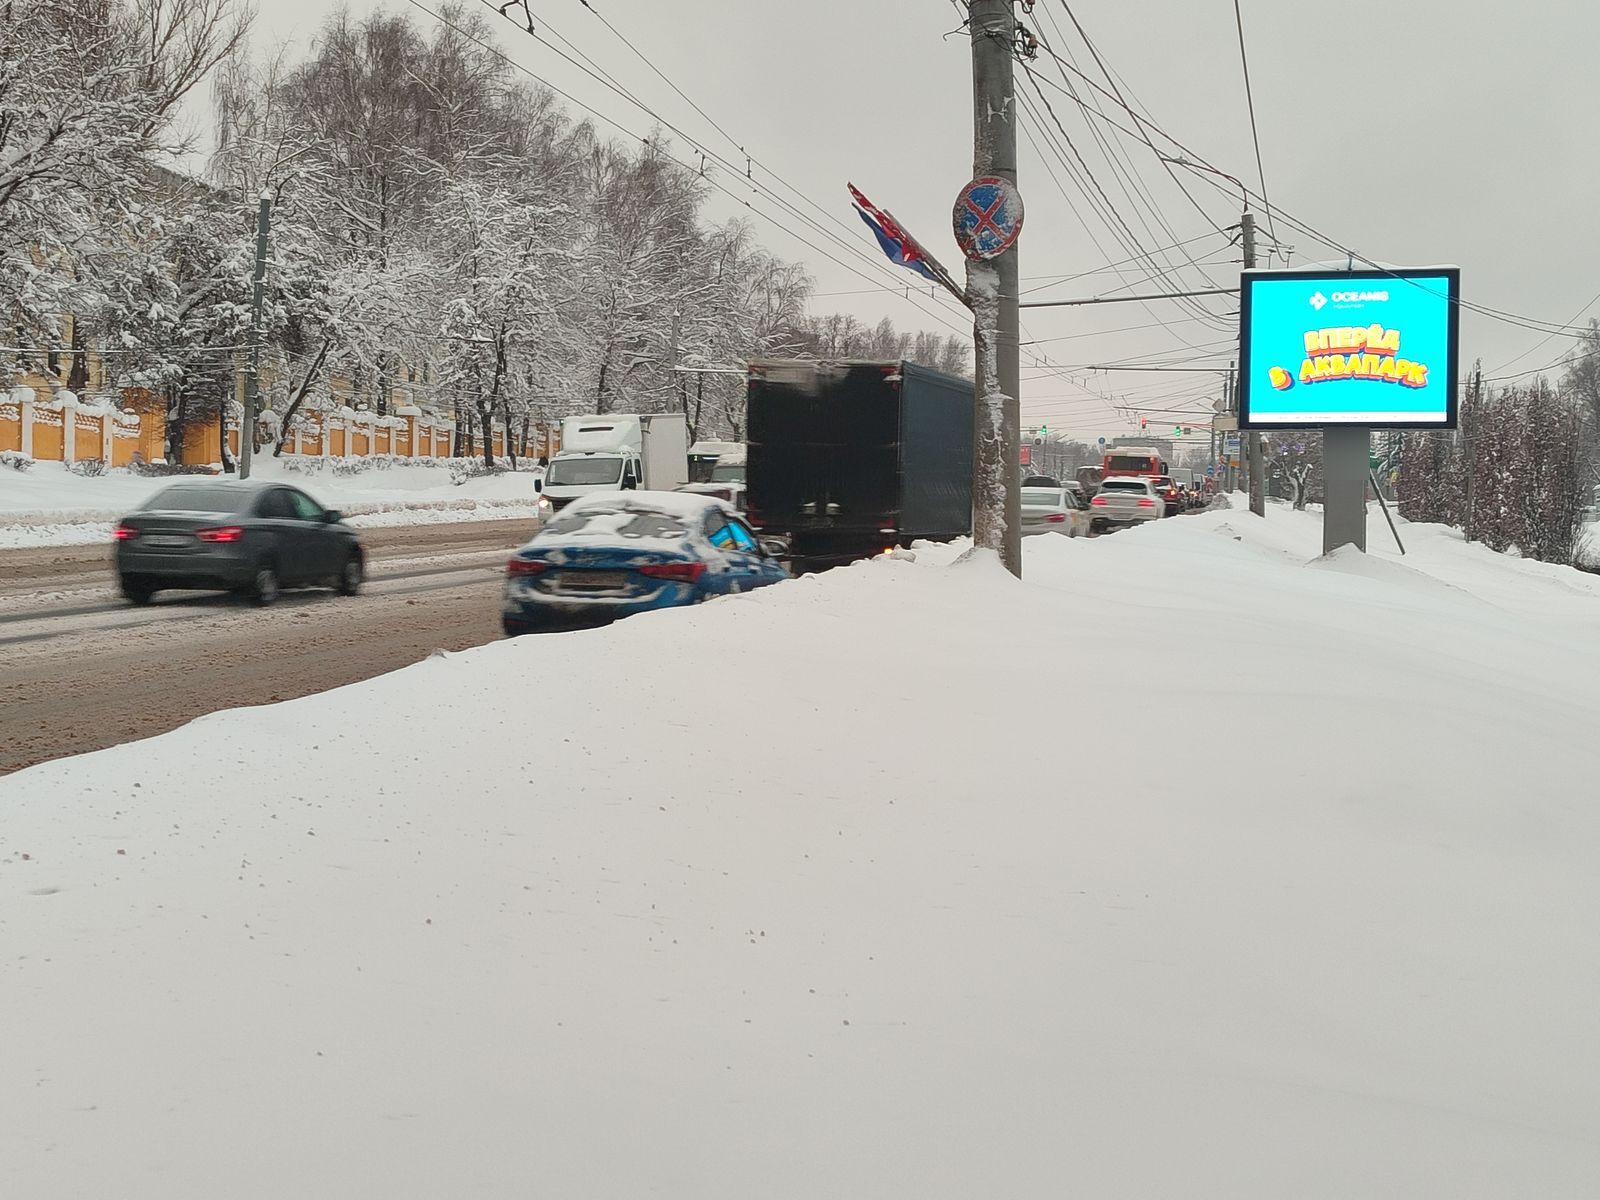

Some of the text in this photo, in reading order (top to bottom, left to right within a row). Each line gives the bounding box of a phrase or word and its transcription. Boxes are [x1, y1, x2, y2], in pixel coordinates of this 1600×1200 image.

[1331, 291, 1389, 302] OCEANIS
[1268, 353, 1428, 389] В АКВАПАРК
